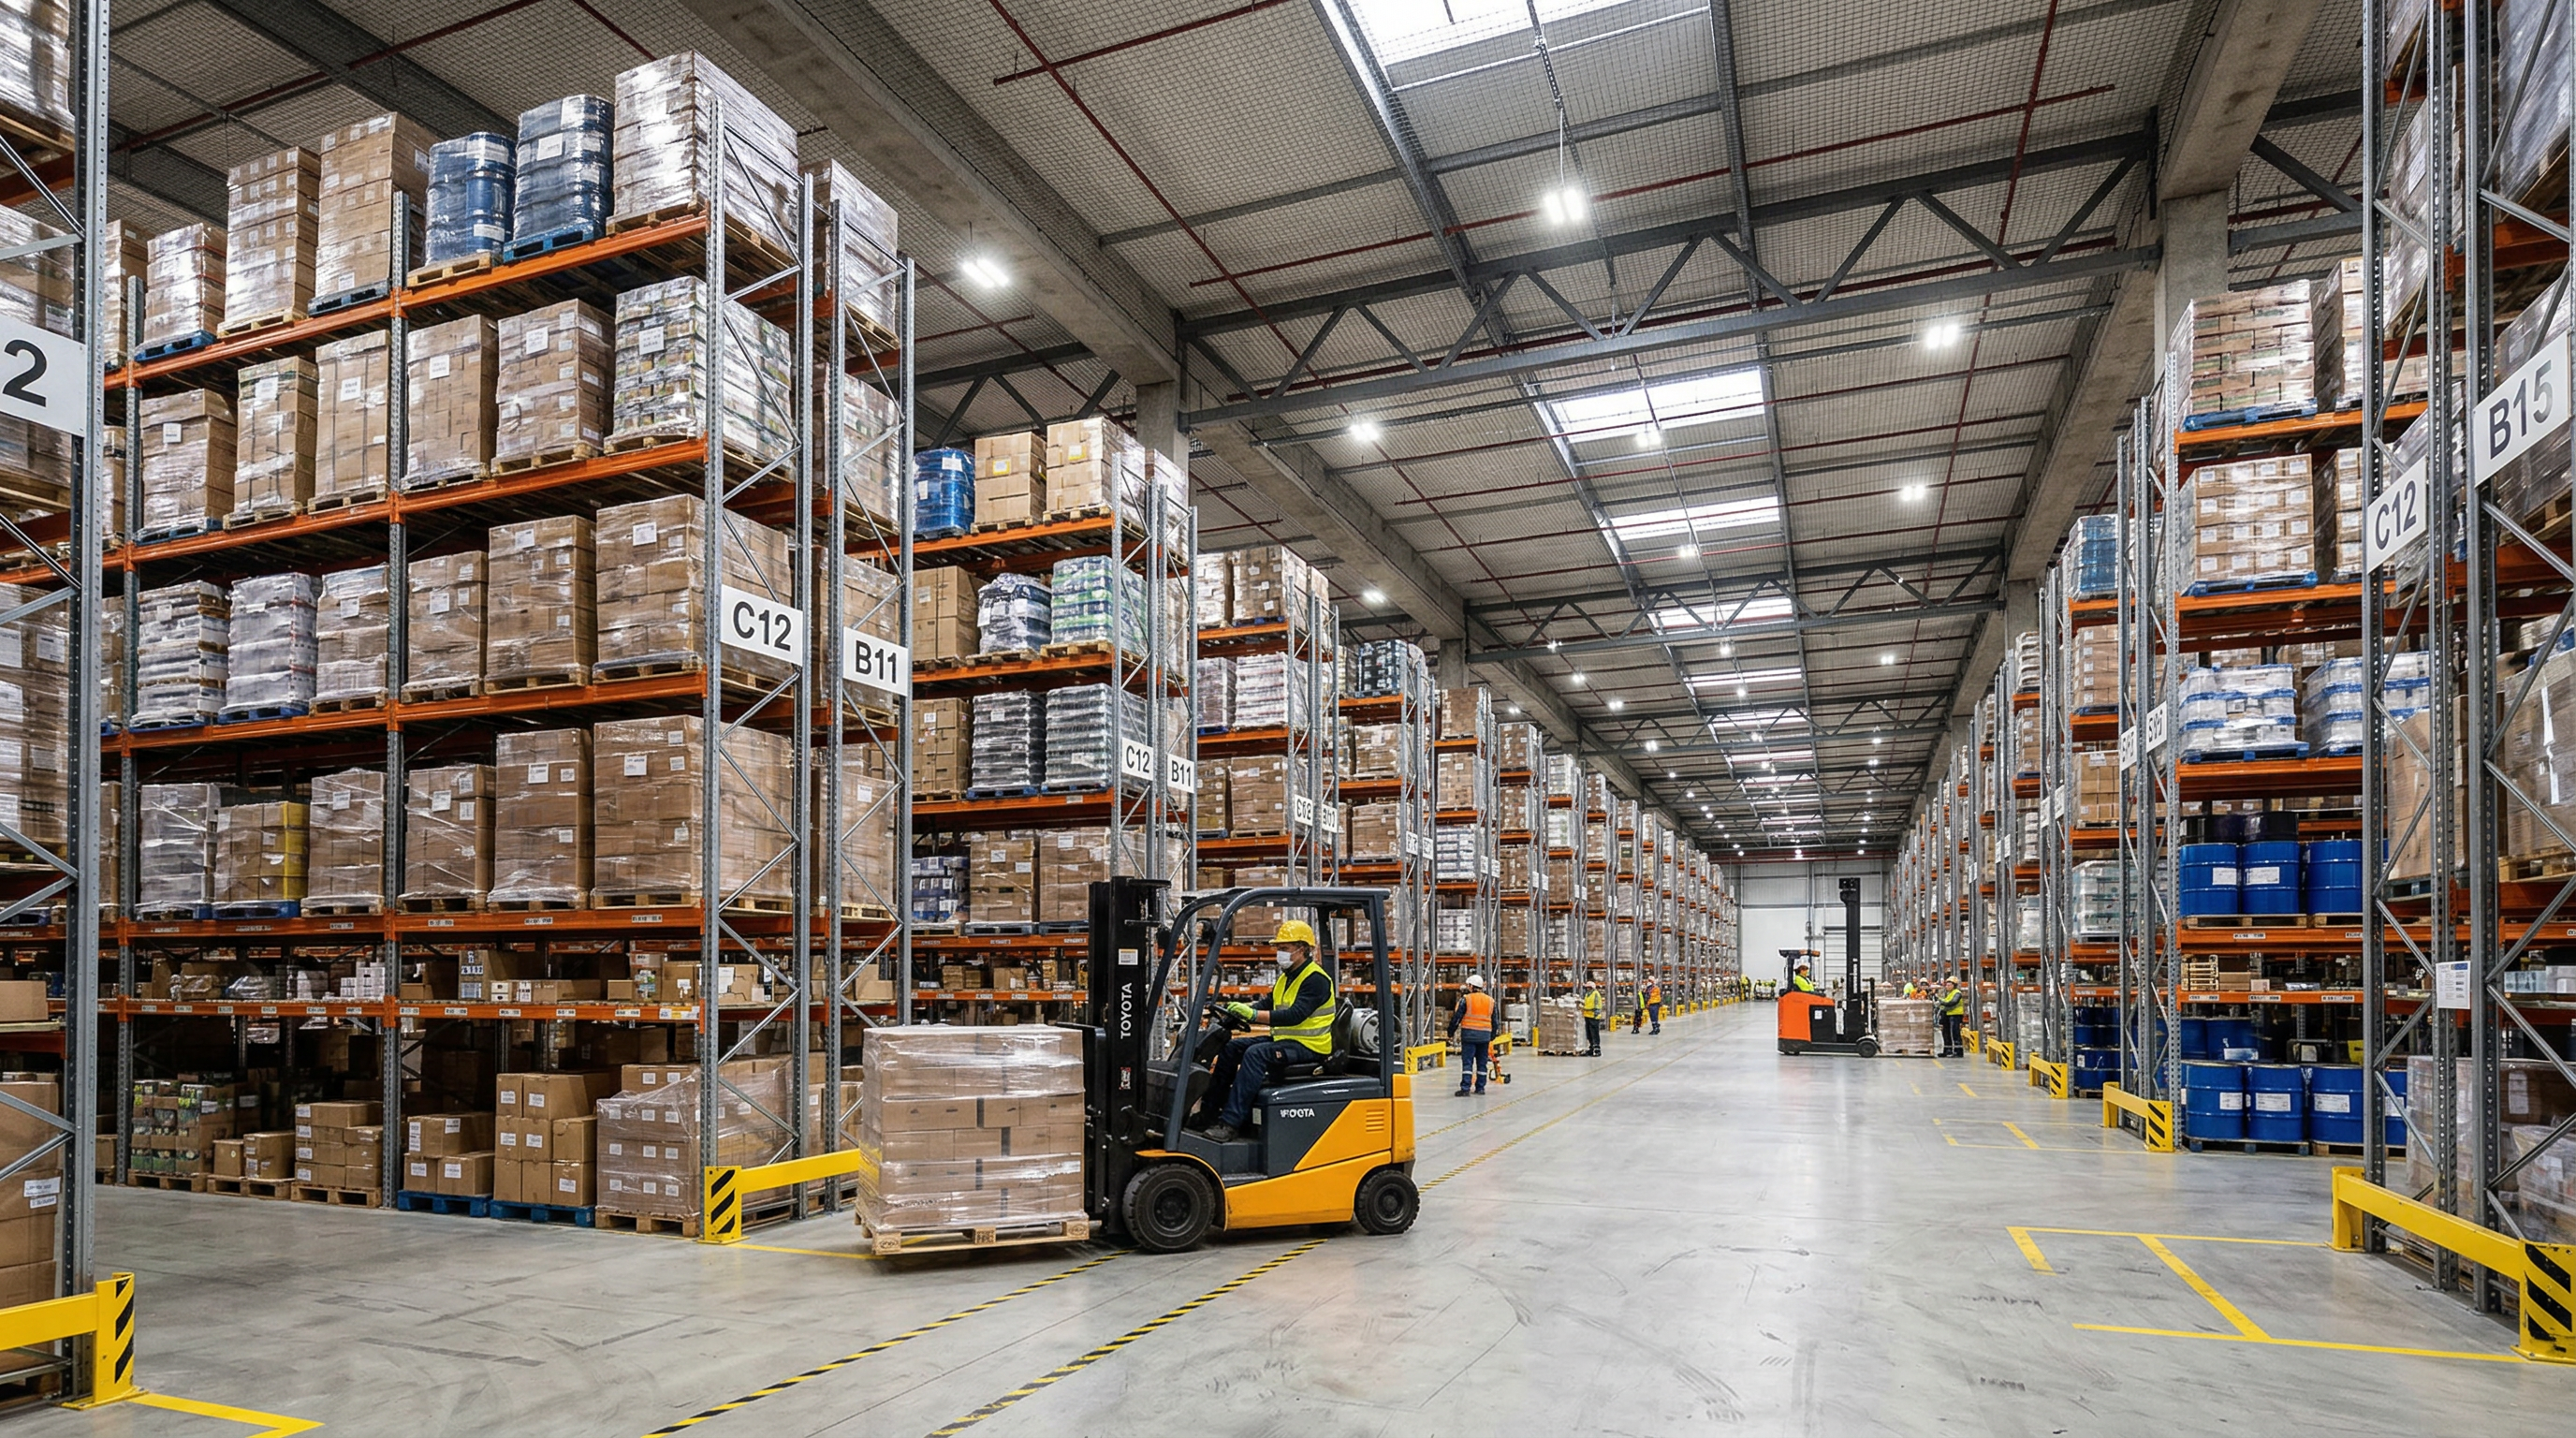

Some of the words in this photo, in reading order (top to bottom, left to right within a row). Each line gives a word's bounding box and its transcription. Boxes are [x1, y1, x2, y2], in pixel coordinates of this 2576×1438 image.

[2489, 360, 2554, 460] B15
[2375, 480, 2417, 550] C12
[733, 601, 792, 652] C12
[856, 639, 897, 684] B11
[1126, 745, 1150, 773] C12
[1171, 759, 1191, 787] B11
[1120, 982, 1133, 1040] TOYOTA
